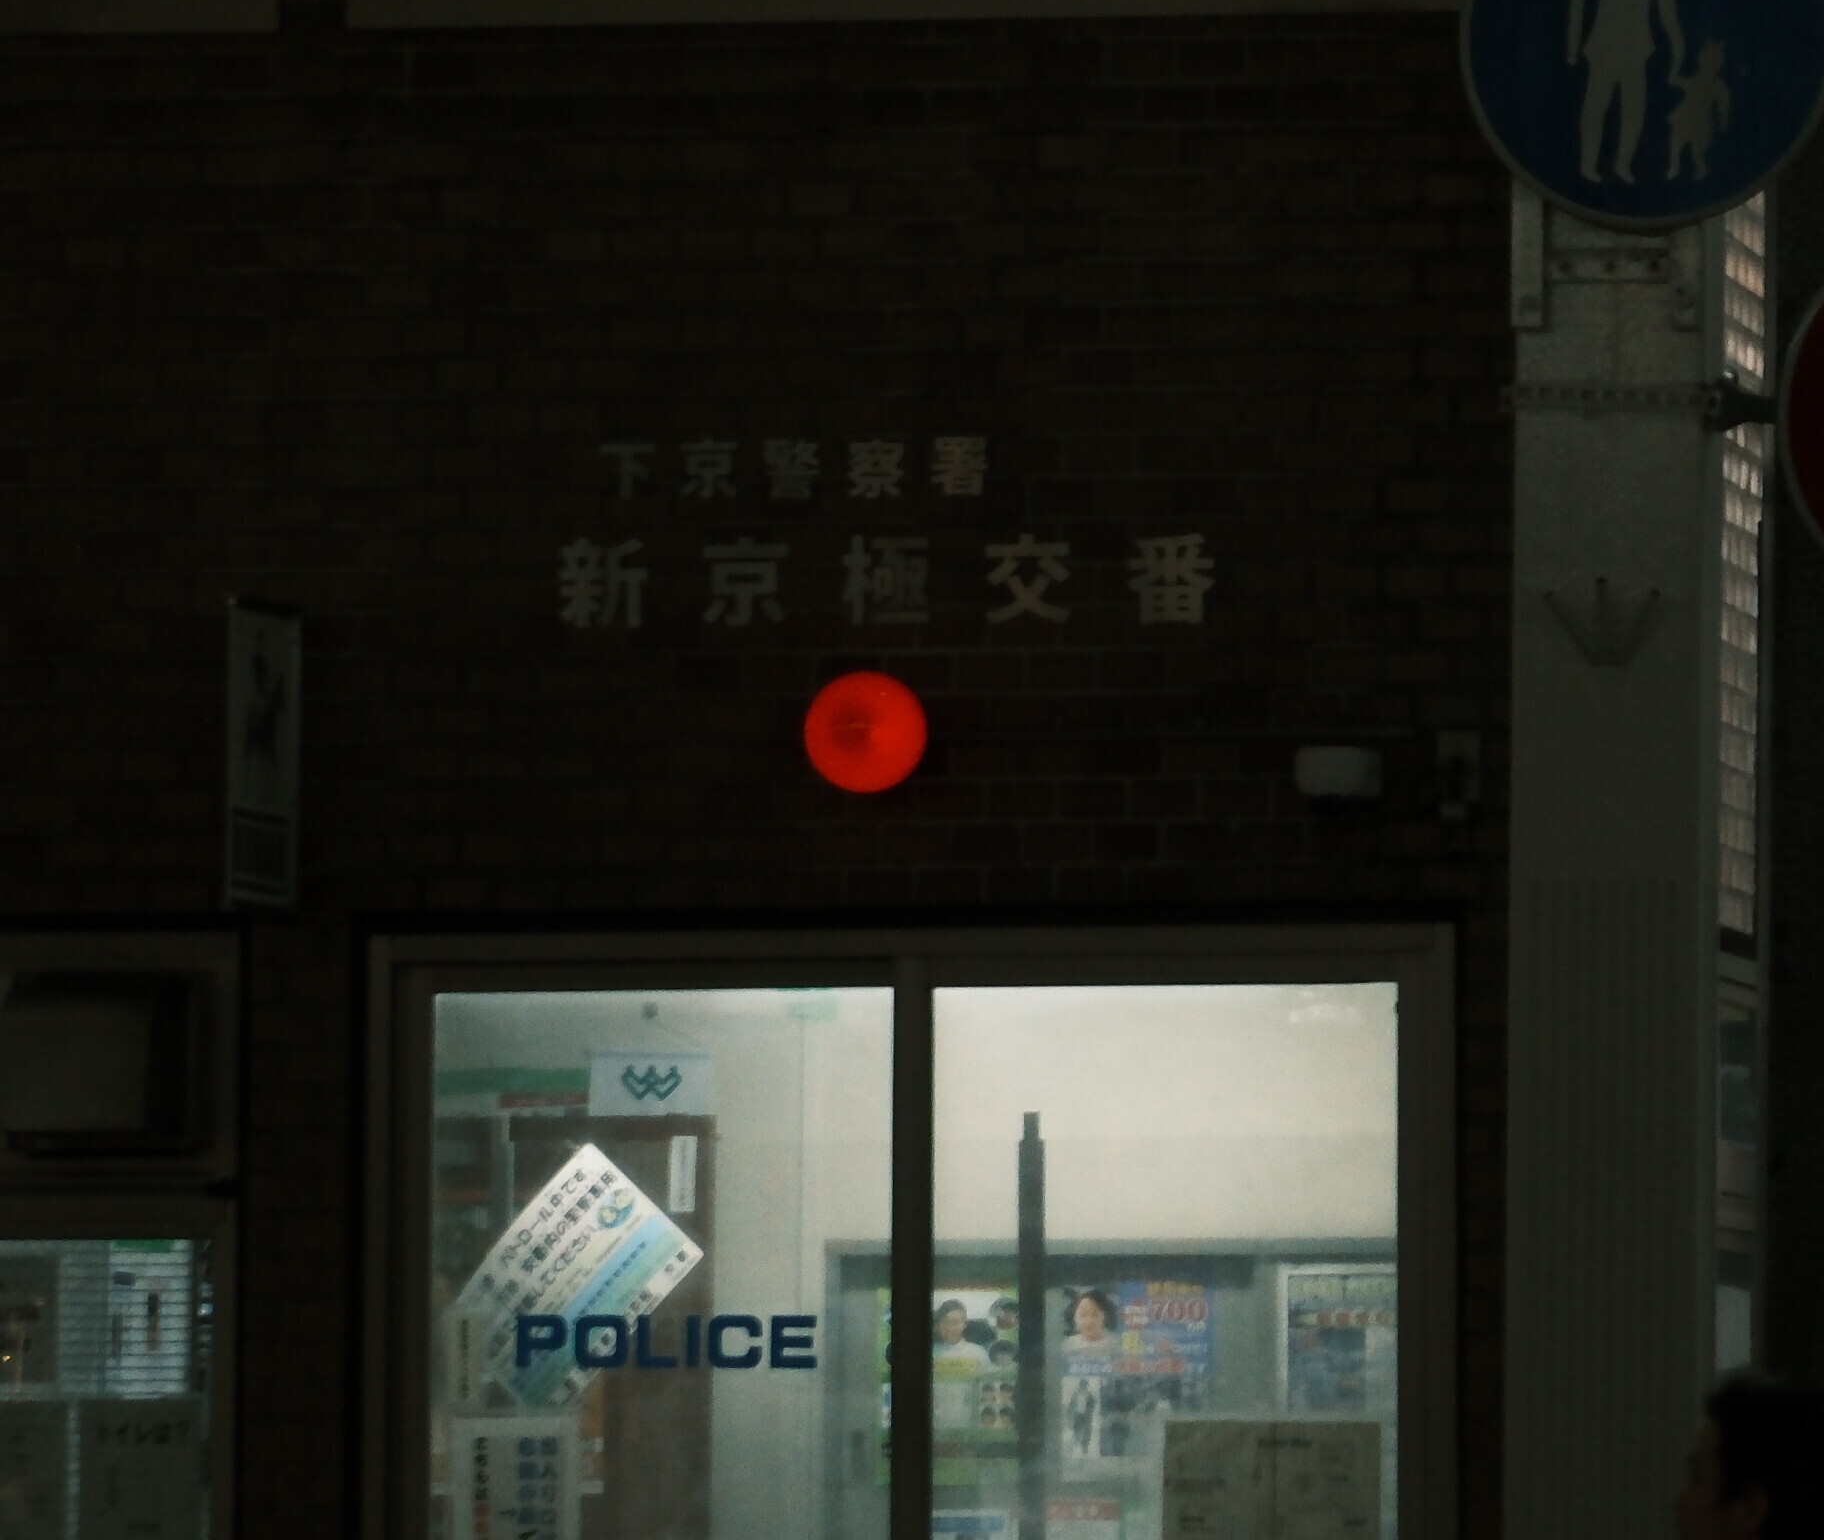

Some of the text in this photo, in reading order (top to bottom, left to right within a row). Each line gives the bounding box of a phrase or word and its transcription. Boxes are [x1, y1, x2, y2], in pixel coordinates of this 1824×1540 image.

[600, 436, 989, 500] 下京警察署
[557, 533, 1214, 628] 新京極交番
[513, 1315, 818, 1370] POLICE
